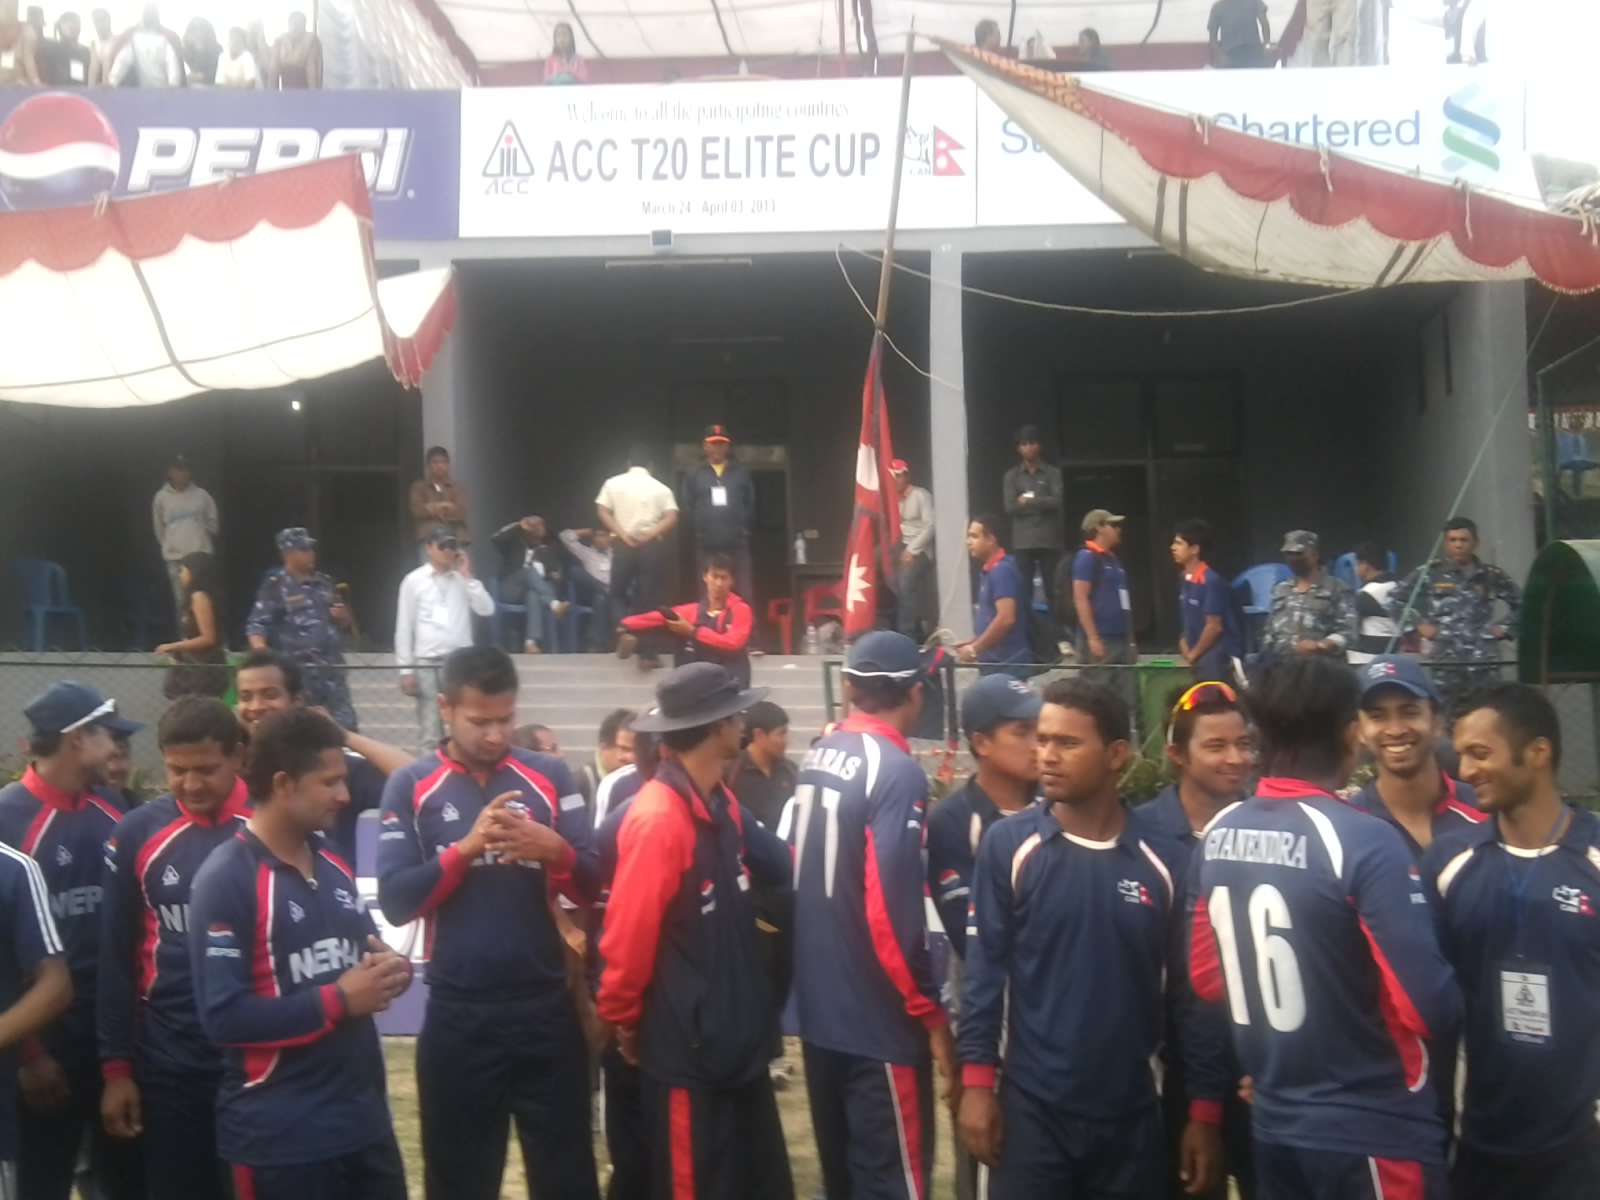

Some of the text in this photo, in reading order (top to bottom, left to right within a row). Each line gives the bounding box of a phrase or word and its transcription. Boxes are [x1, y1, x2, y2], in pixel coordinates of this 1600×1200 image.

[566, 100, 629, 122] Welcome
[672, 100, 692, 121] the
[697, 101, 782, 127] participating
[786, 99, 850, 118] countries
[545, 132, 880, 182] ACC T20 ELITE CUP
[641, 201, 675, 215] March
[679, 200, 691, 215] 24
[702, 199, 728, 217] April
[750, 198, 776, 214] 2013
[49, 885, 104, 919] NEP
[1207, 883, 1307, 1033] 16
